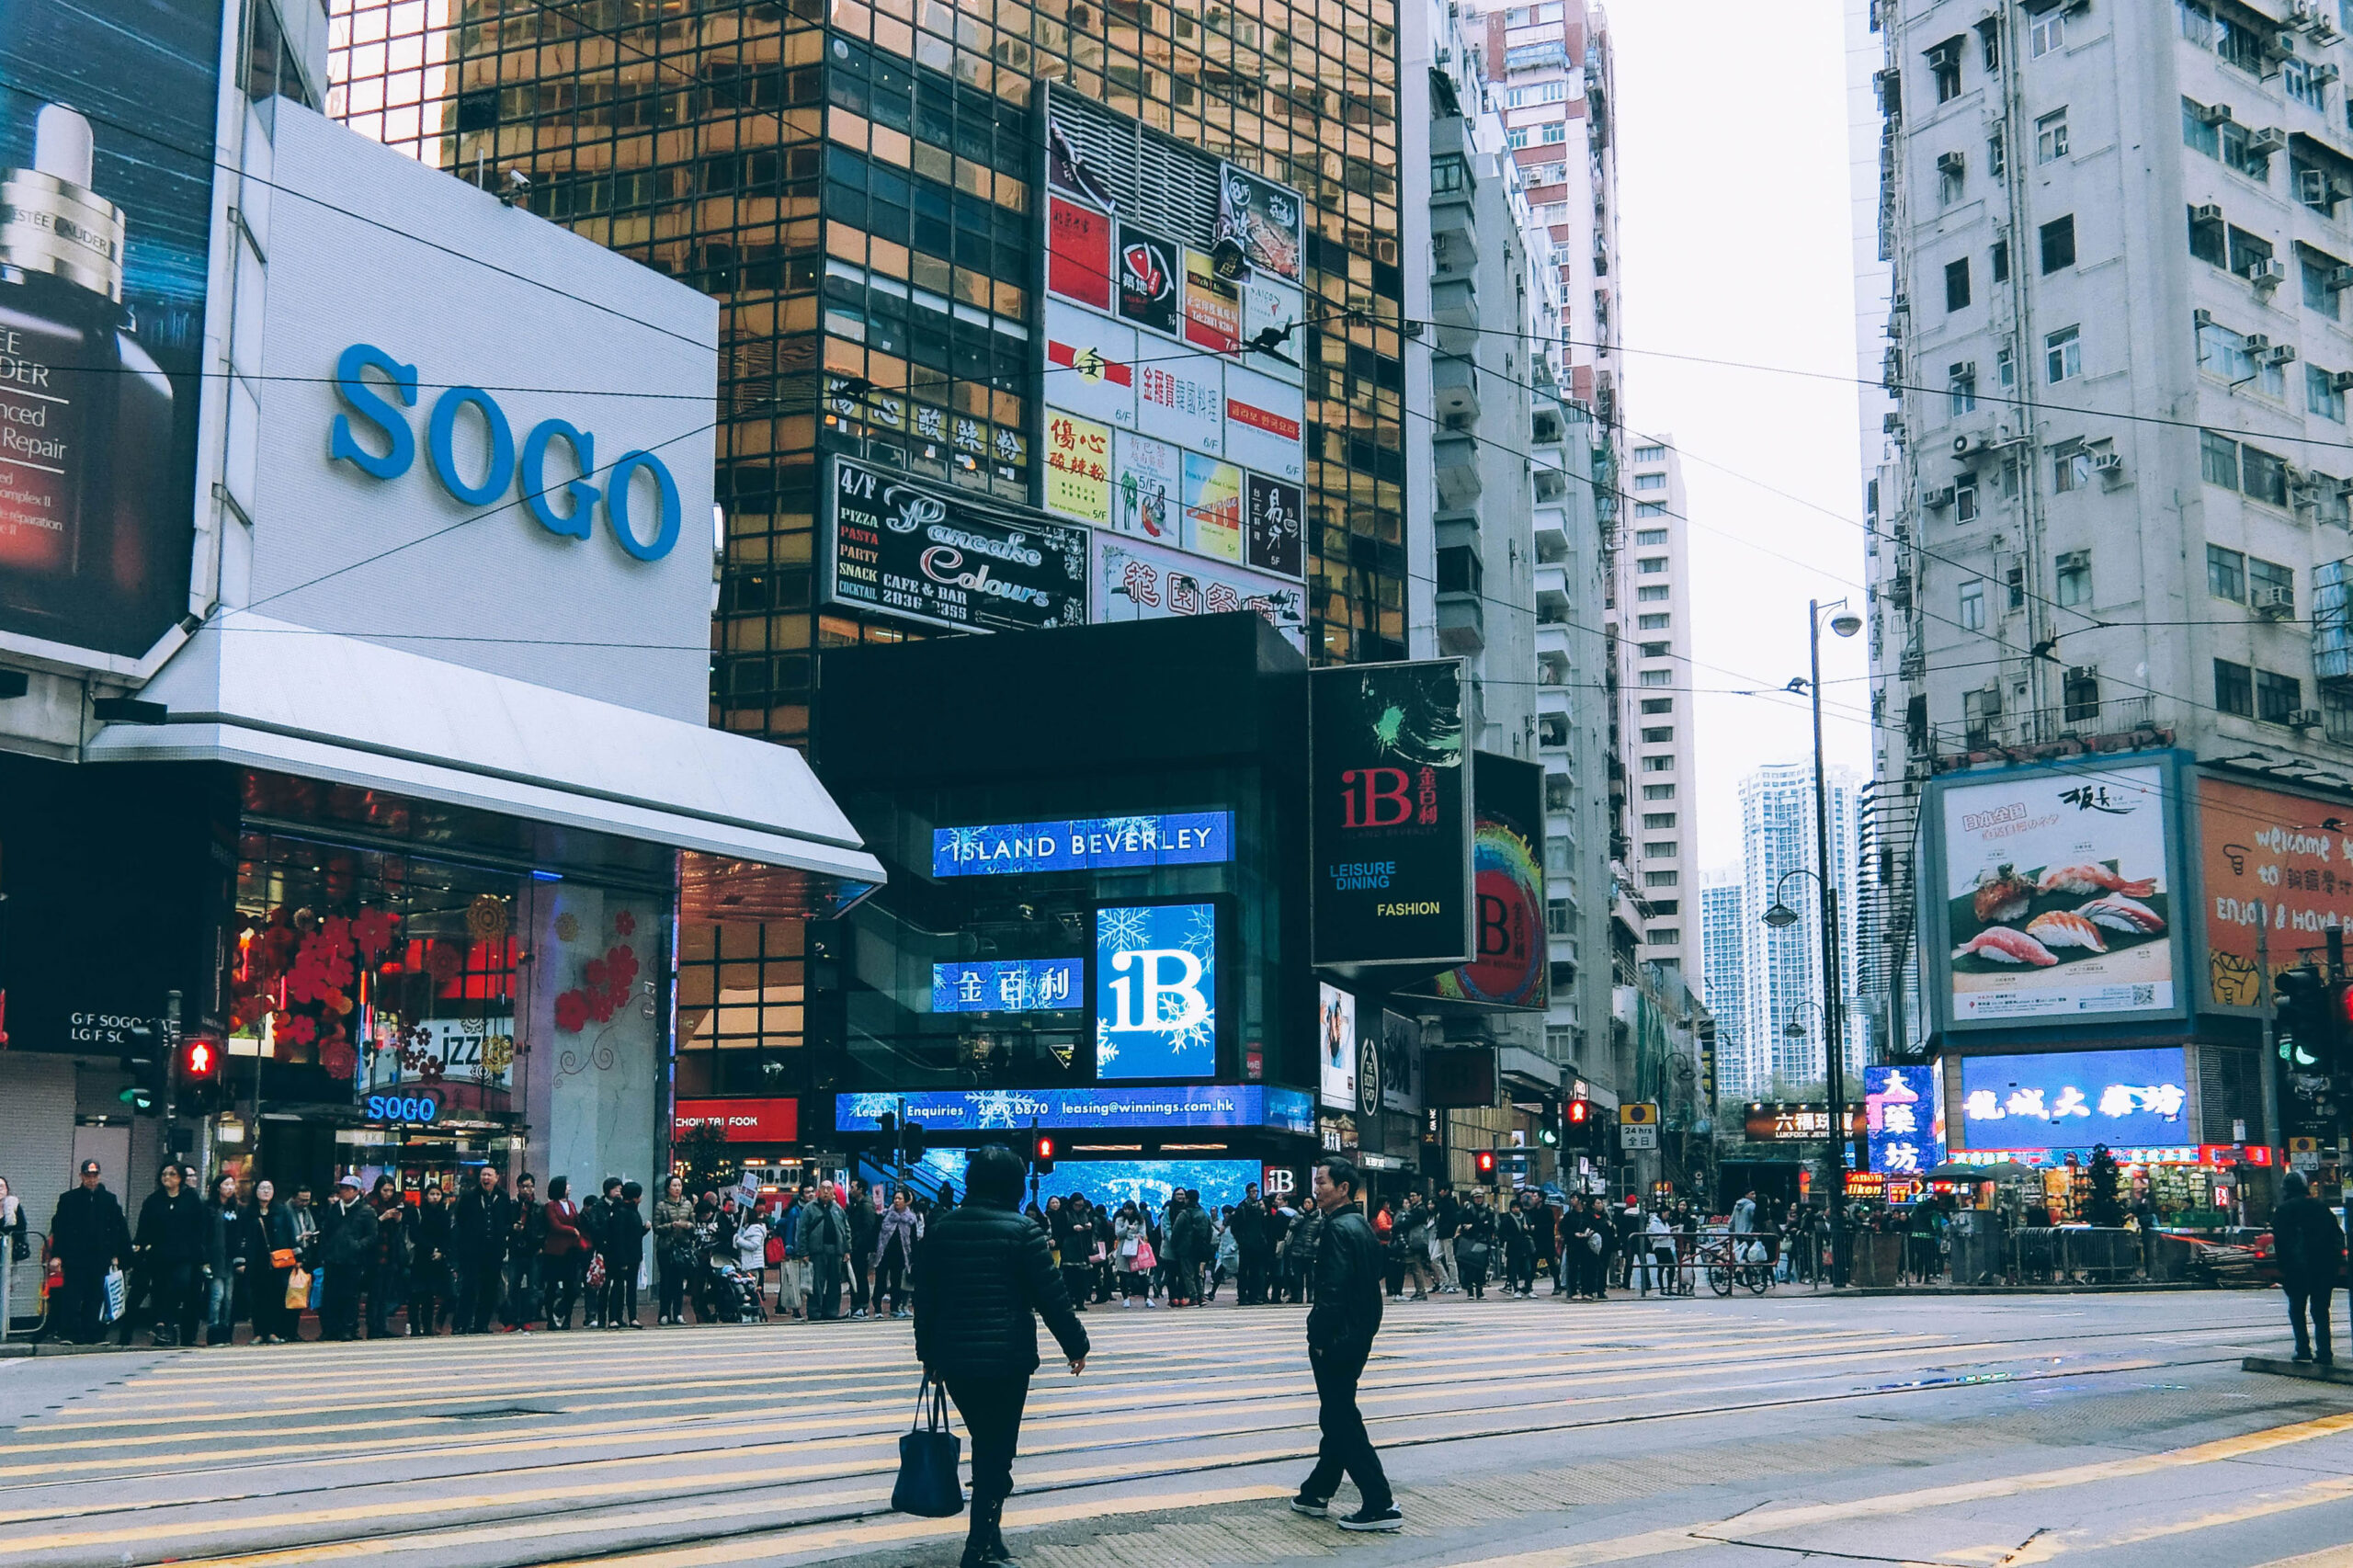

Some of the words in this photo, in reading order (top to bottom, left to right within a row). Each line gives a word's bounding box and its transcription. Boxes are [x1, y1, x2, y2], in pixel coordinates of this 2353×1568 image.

[1115, 408, 1131, 423] 6/F
[3, 426, 67, 460] Repair
[1051, 418, 1107, 454] 傷心
[1203, 436, 1219, 450] 6/F
[330, 343, 682, 562] SOGO
[1049, 451, 1107, 483] 酸辣粉
[1286, 464, 1301, 476] 6/F
[840, 468, 877, 500] 4/F
[1138, 476, 1156, 492] 5/F
[840, 506, 879, 528] PIZZA
[883, 485, 1042, 567] Pancake
[840, 525, 879, 546] PASTA
[839, 543, 879, 564] PARTY
[839, 562, 877, 584] SNACK
[920, 546, 1050, 608] Colours
[838, 580, 878, 601] COCKTAIL
[883, 573, 919, 595] CAFE
[921, 582, 934, 597] &
[938, 585, 967, 605] BAR
[1341, 767, 1413, 828] iB
[1417, 766, 1438, 825] 金百利
[2058, 785, 2123, 812] 板長
[952, 835, 1055, 862] ISLAND
[1071, 826, 1212, 856] BEVERLEY
[2255, 826, 2330, 863] welcome
[1330, 861, 1396, 878] LEISURE
[1336, 875, 1390, 891] DINING
[1377, 902, 1440, 916] FASHION
[954, 966, 1070, 1007] 金百利
[1109, 949, 1207, 1032] iB
[1364, 1074, 1375, 1088] BODY
[1365, 1088, 1375, 1101] SHOP
[368, 1096, 436, 1121] SOGO
[906, 1104, 964, 1119] Enquiries
[1014, 1103, 1049, 1115] 6870
[1062, 1099, 1234, 1116] leasing@winnings.com.hk
[676, 1117, 705, 1128] CHOW
[708, 1117, 724, 1126] TAI
[728, 1116, 758, 1127] FOOK
[1624, 1127, 1636, 1135] 24
[1639, 1127, 1653, 1135] hrs
[1882, 1069, 1919, 1171] 大藥坊
[1627, 1136, 1650, 1146] 全日
[1268, 1169, 1294, 1194] iB
[1847, 1174, 1883, 1183] anon
